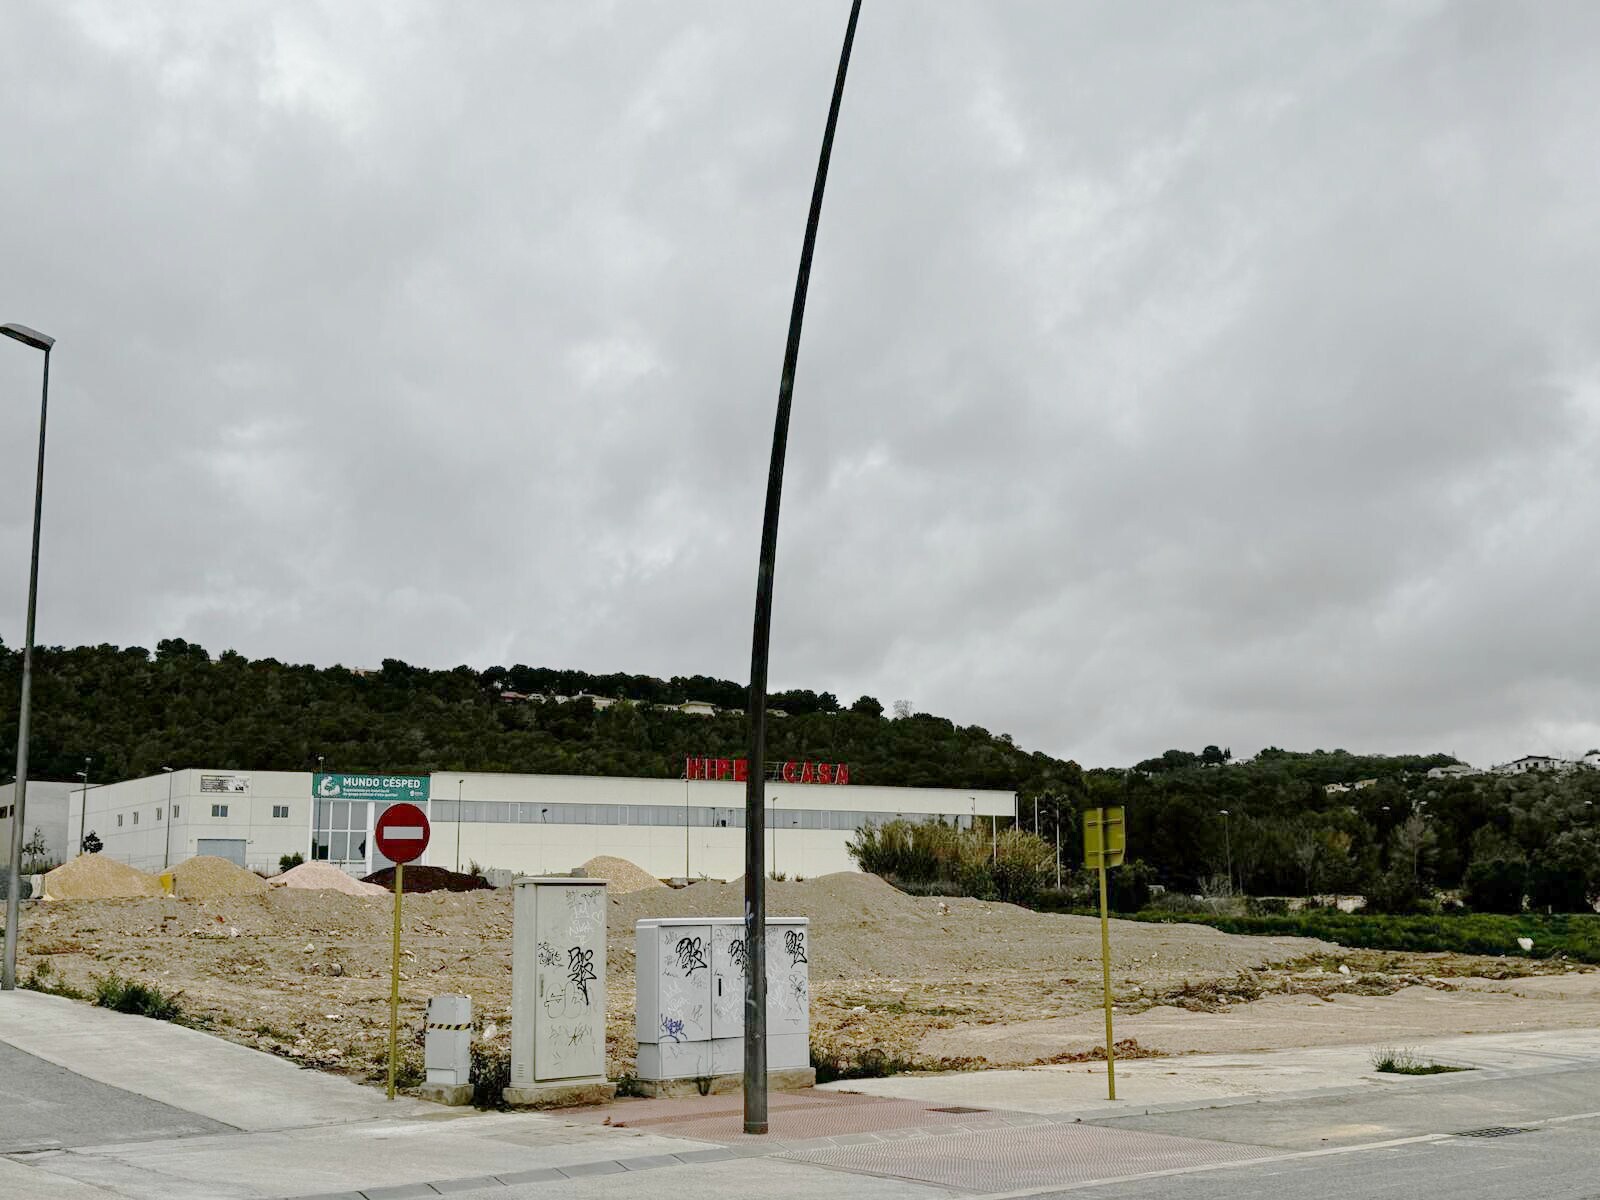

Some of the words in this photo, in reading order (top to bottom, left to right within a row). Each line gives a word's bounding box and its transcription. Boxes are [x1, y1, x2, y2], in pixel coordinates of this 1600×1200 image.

[783, 760, 848, 784] CASA
[343, 776, 379, 787] MUNDO
[382, 776, 421, 788] CÉSPED
